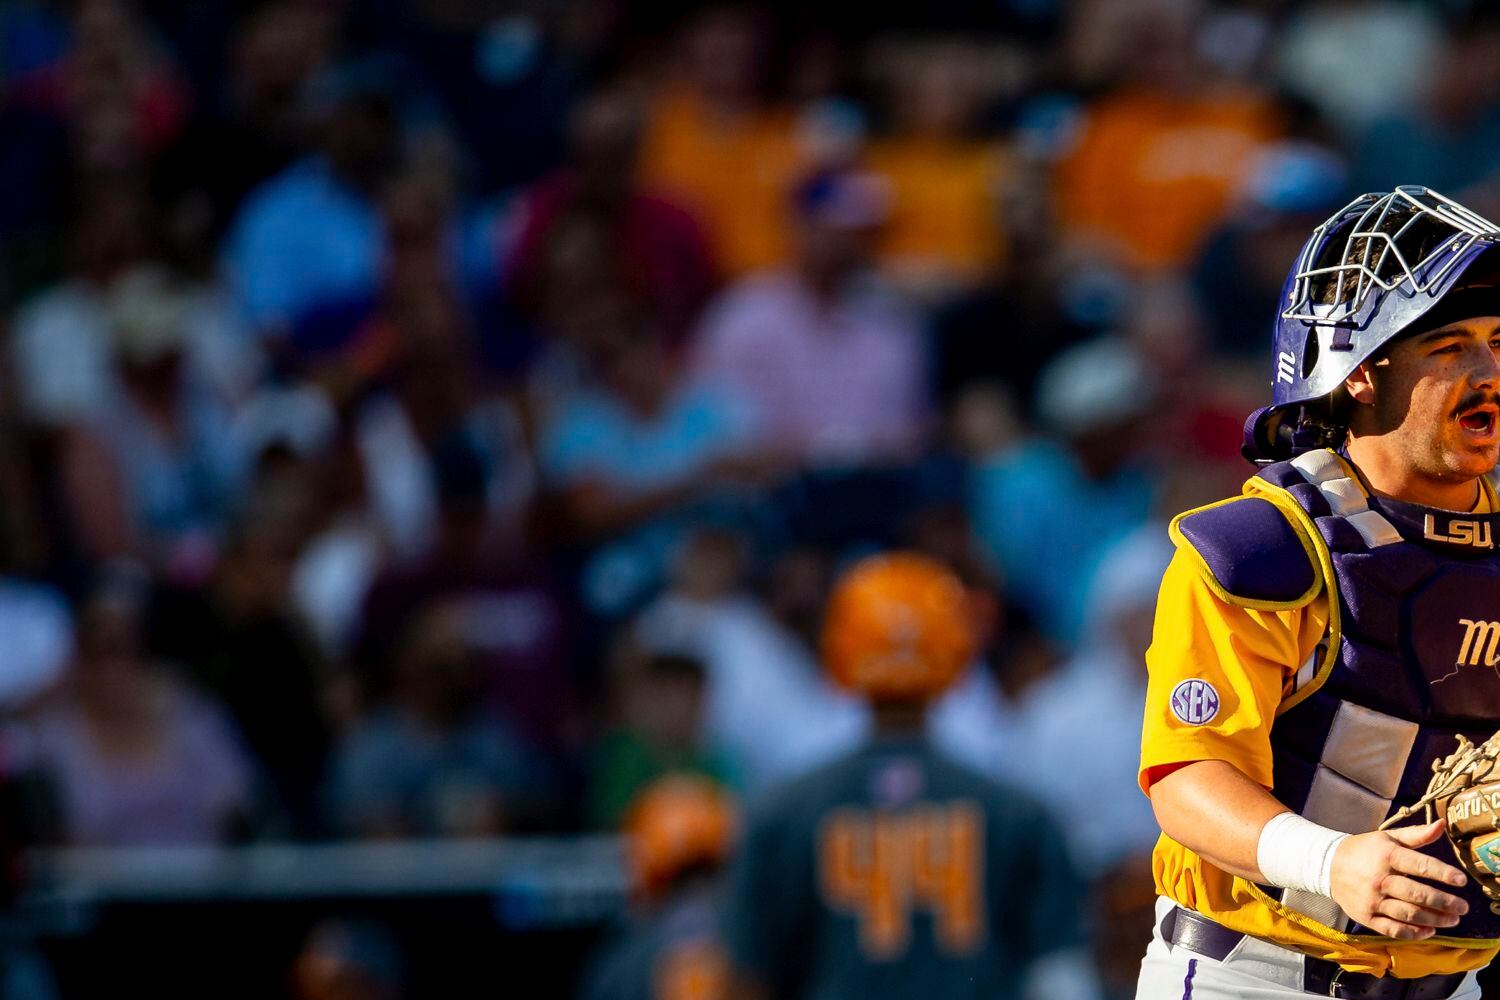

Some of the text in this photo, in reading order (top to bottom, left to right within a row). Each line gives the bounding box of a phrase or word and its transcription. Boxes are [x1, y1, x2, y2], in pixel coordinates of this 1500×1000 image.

[1424, 514, 1491, 547] LSU
[1173, 681, 1218, 724] SEC
[819, 805, 985, 957] 44
